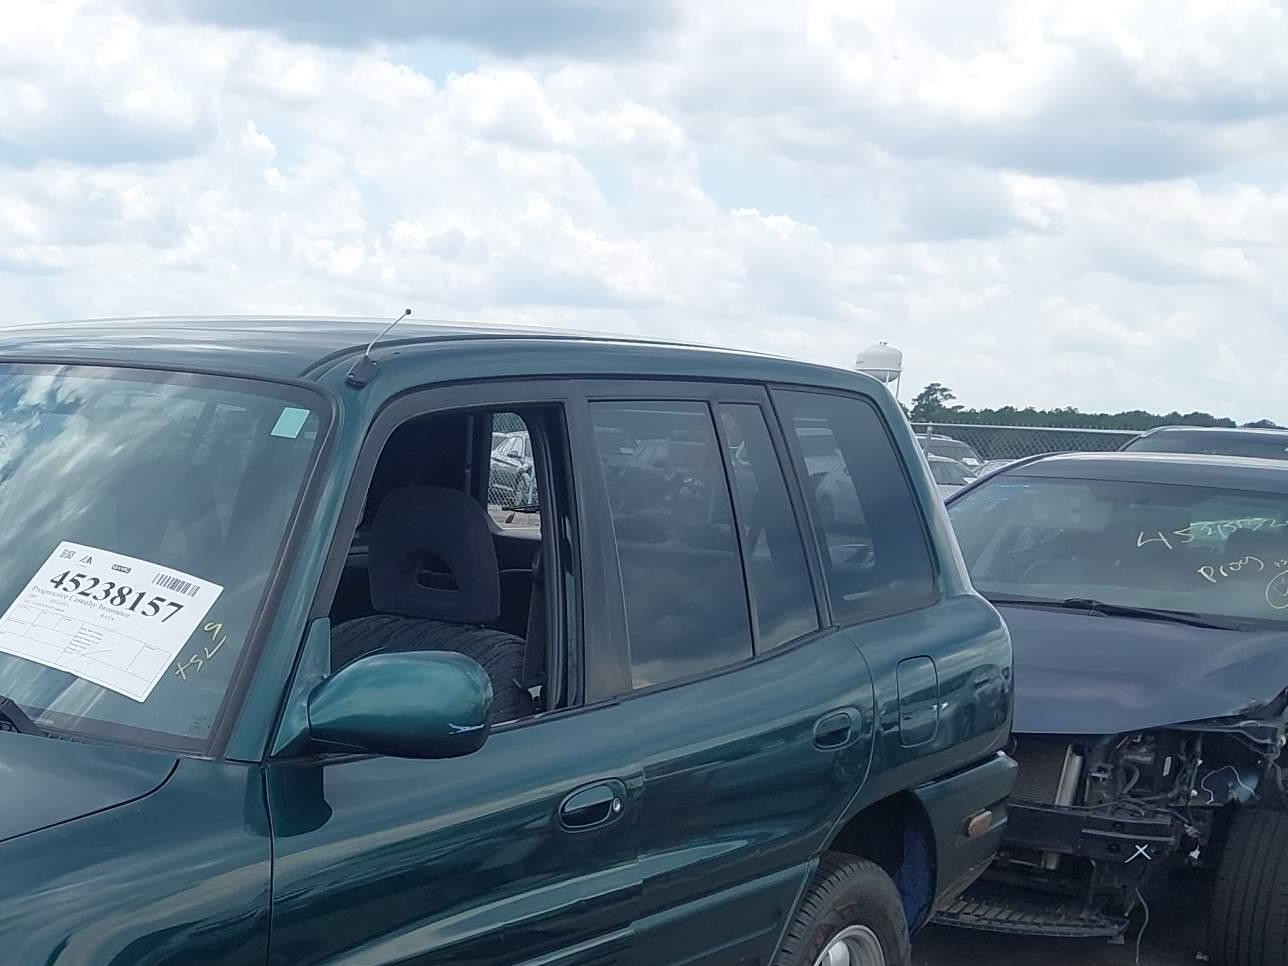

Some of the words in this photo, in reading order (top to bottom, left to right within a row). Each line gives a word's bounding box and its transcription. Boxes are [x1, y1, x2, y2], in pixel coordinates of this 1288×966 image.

[32, 585, 69, 600] Progressive
[69, 594, 97, 609] Casualty
[98, 602, 131, 619] Insurance
[49, 568, 184, 623] 45238157
